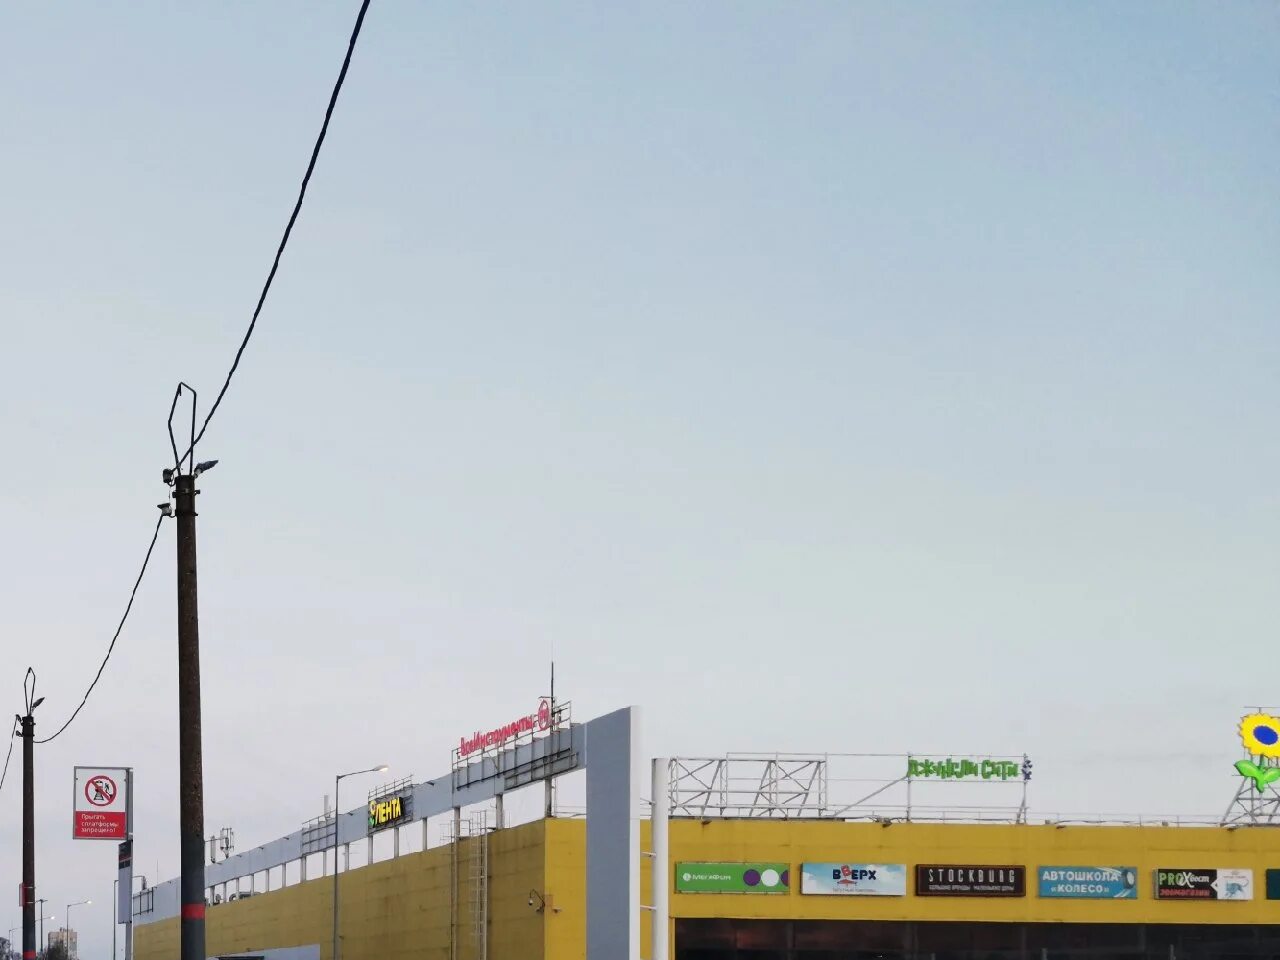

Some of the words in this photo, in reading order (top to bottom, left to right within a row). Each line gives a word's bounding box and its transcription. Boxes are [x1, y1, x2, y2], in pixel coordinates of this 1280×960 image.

[375, 797, 401, 825] ЛЕНТА
[928, 868, 1015, 883] STOCKBURG
[1042, 870, 1119, 882] АВТОШКОЛА
